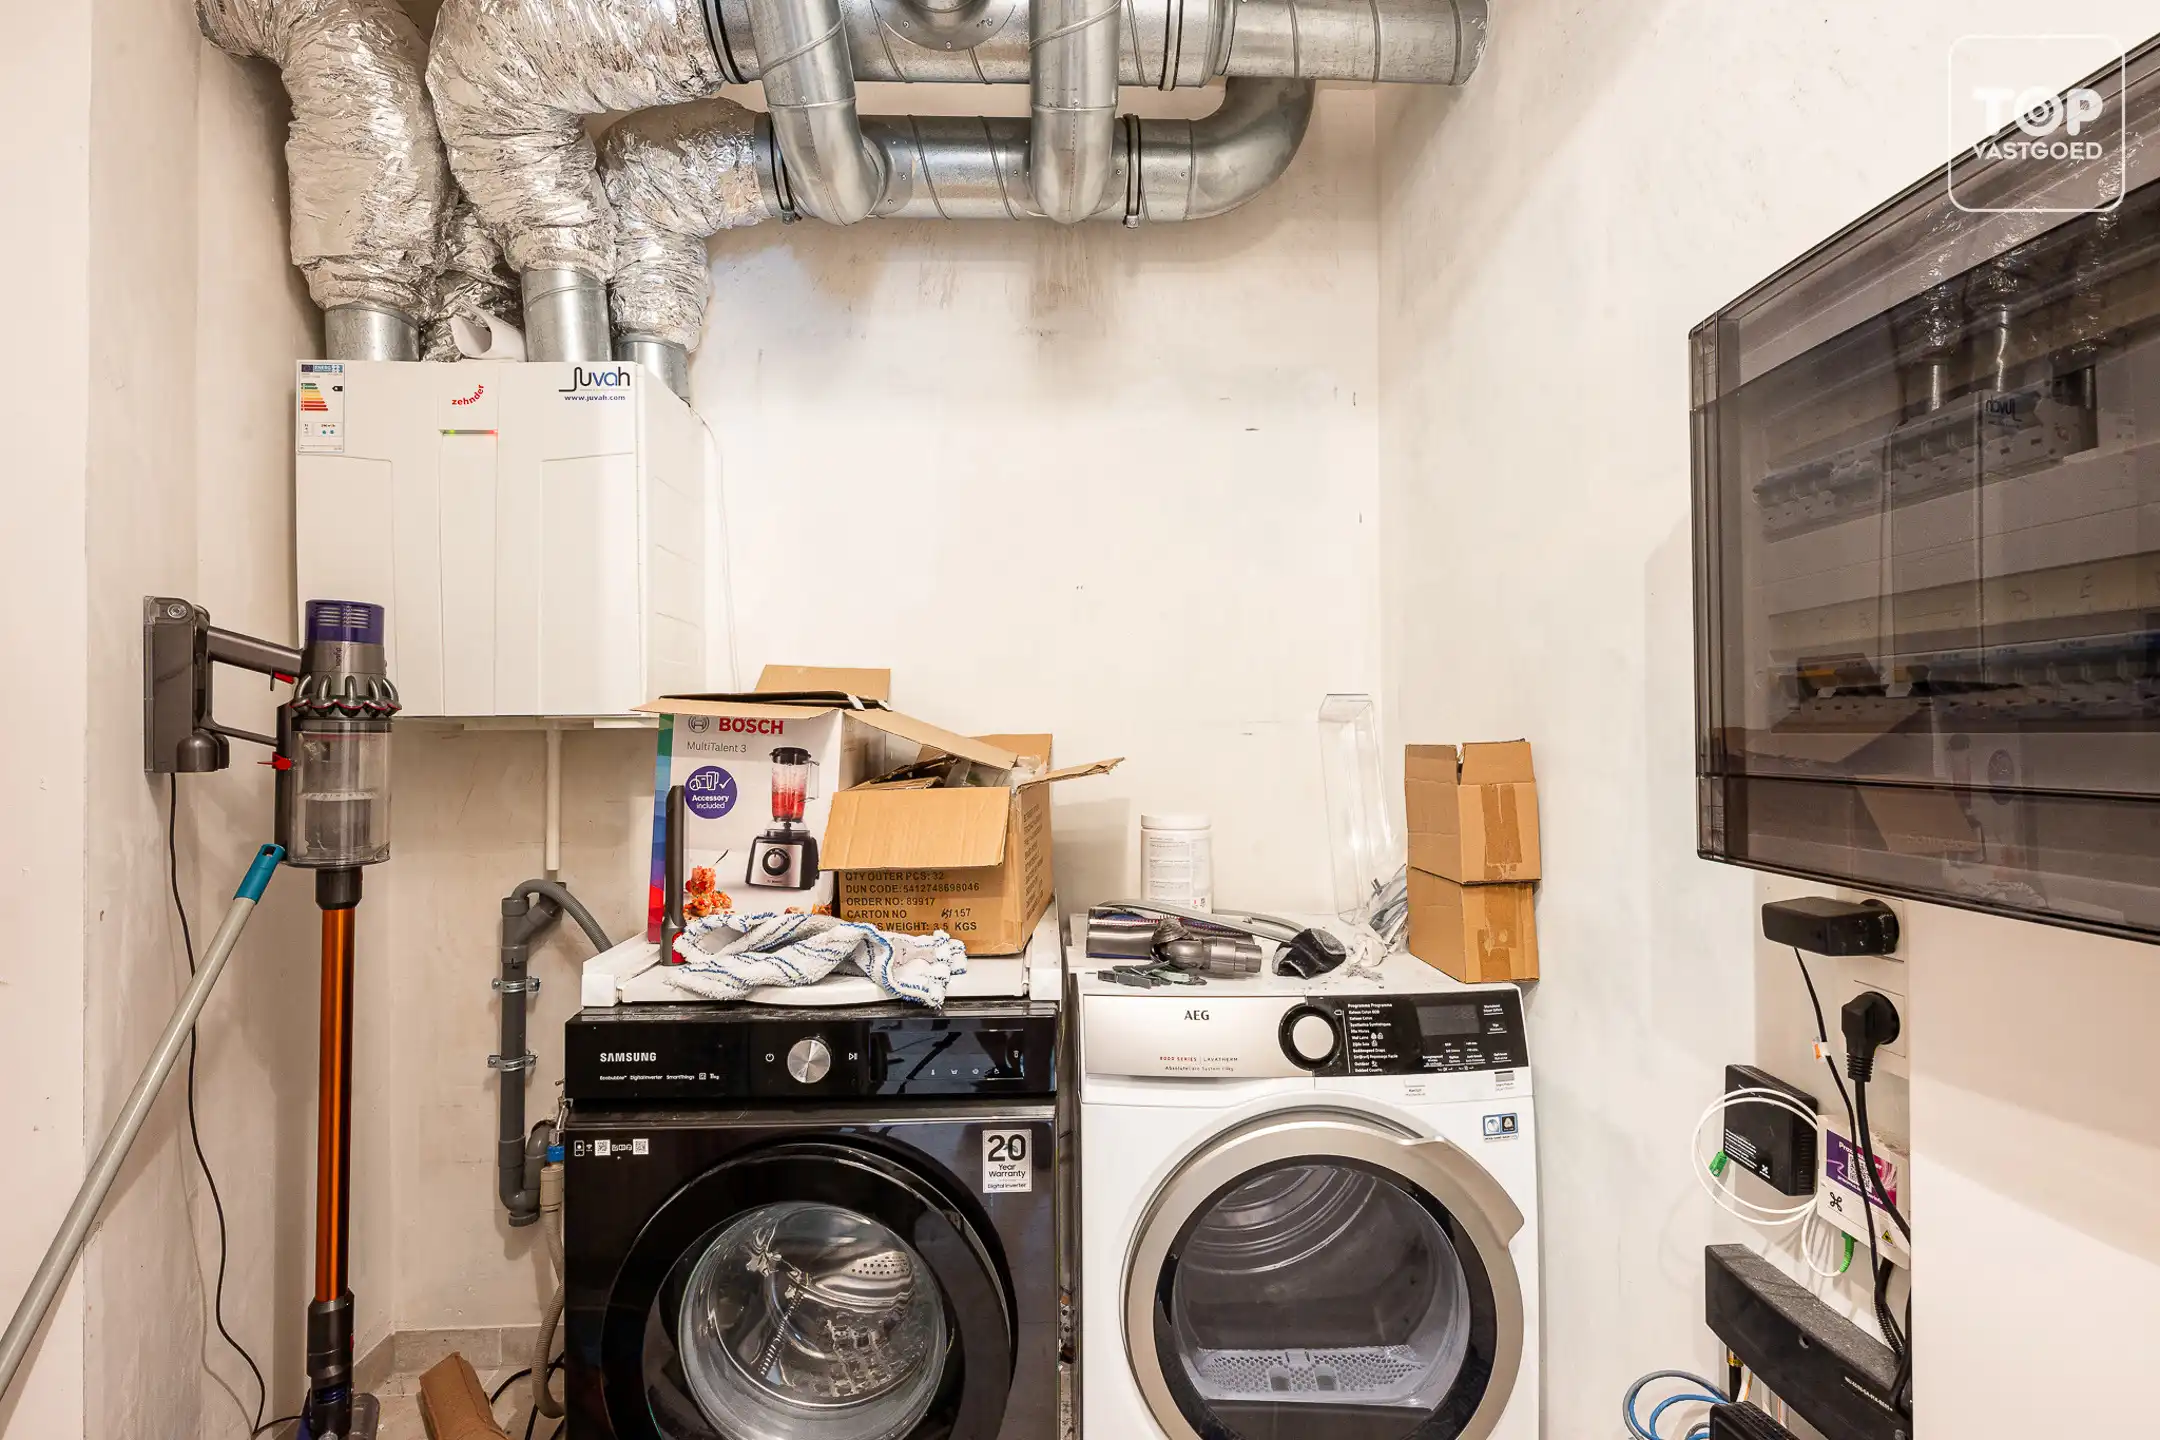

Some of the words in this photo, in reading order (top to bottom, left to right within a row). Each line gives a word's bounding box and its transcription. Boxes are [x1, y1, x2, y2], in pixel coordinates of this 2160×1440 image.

[451, 384, 484, 406] zehnder
[718, 717, 784, 735] BOSCH
[687, 741, 738, 753] MultiTalent
[740, 744, 747, 753] 3
[691, 794, 730, 803] Accessory
[845, 871, 865, 881] QTY
[867, 871, 903, 881] OUTER
[905, 871, 930, 881] PCS:
[933, 871, 944, 880] 32
[846, 884, 867, 894] DUN
[869, 884, 902, 893] CODE:
[846, 897, 882, 906] ORDER
[884, 897, 904, 906] NO:
[906, 897, 936, 906] 89917
[846, 909, 889, 919] CARTON
[891, 909, 907, 919] NO
[886, 921, 929, 931] WEIGHT:
[955, 921, 977, 931] KGS
[1183, 1009, 1210, 1021] AEG
[599, 1052, 657, 1062] SAMSUNG
[987, 1133, 1026, 1162] 20
[988, 1170, 1026, 1178] Warranty
